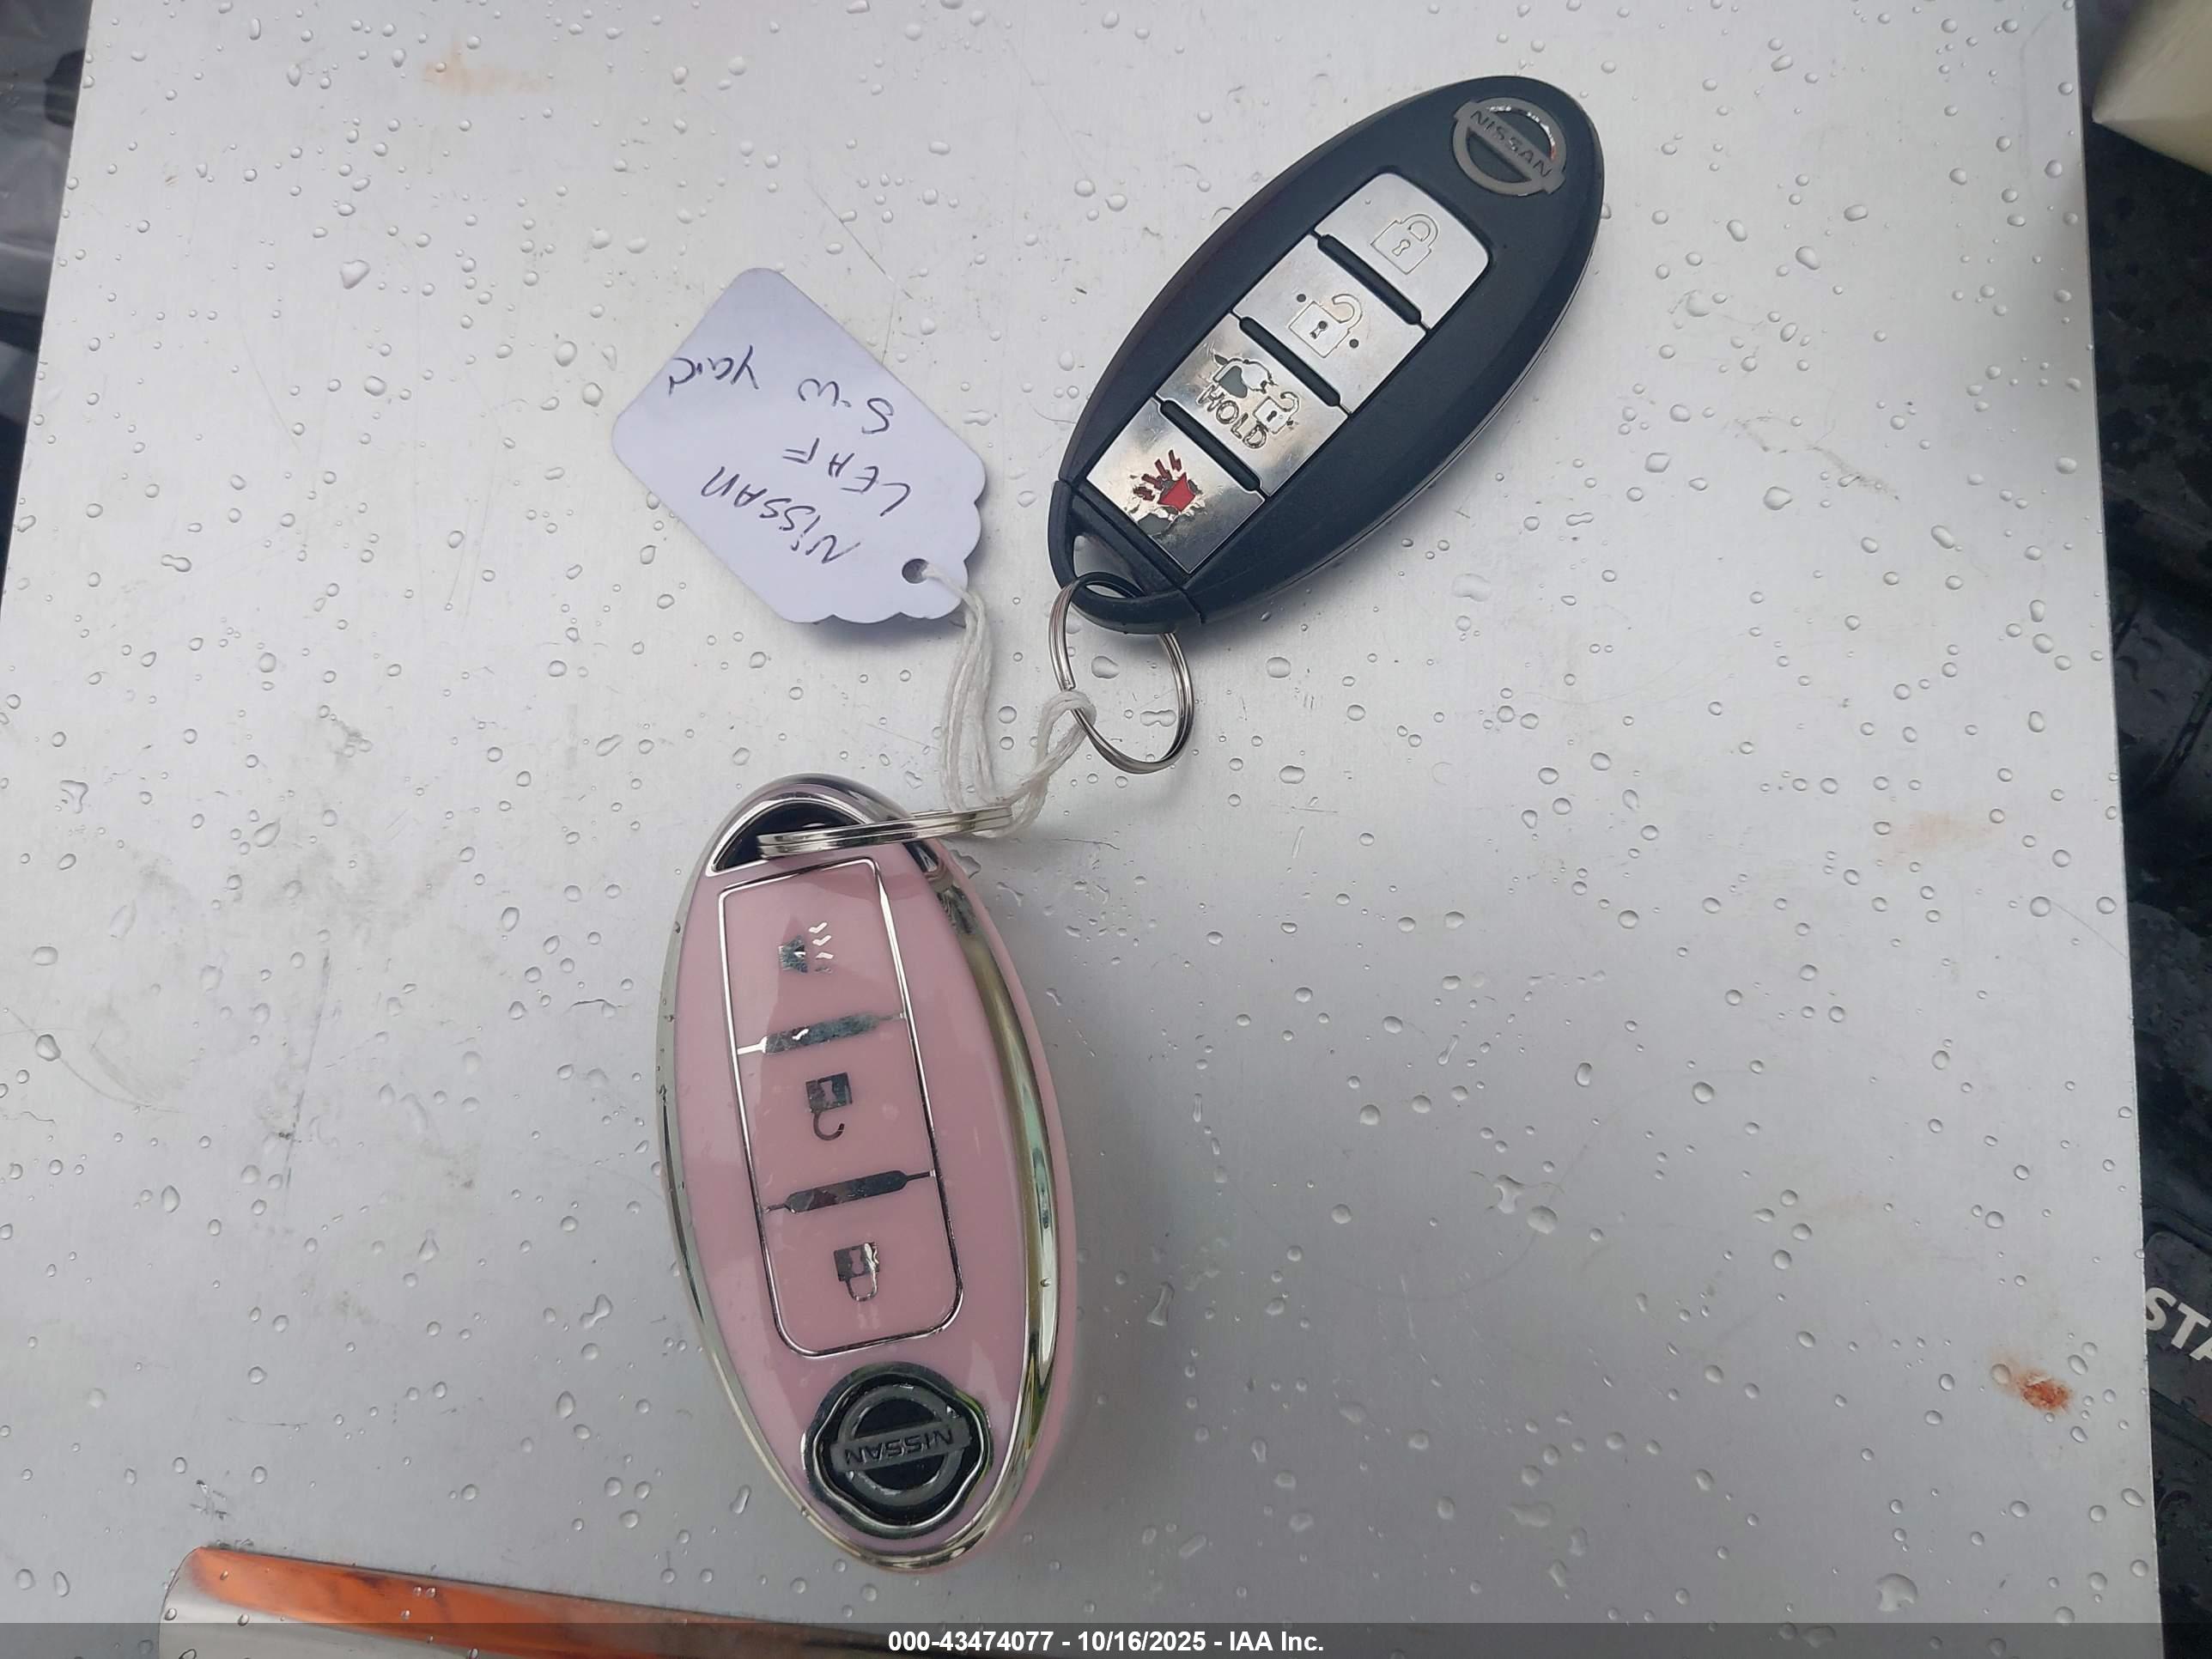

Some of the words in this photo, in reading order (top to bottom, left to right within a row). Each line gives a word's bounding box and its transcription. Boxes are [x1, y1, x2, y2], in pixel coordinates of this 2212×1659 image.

[1469, 110, 1553, 178] NISSAN
[1196, 385, 1267, 448] HOLD
[781, 437, 912, 517] LEAF
[845, 1426, 953, 1465] NISSAN
